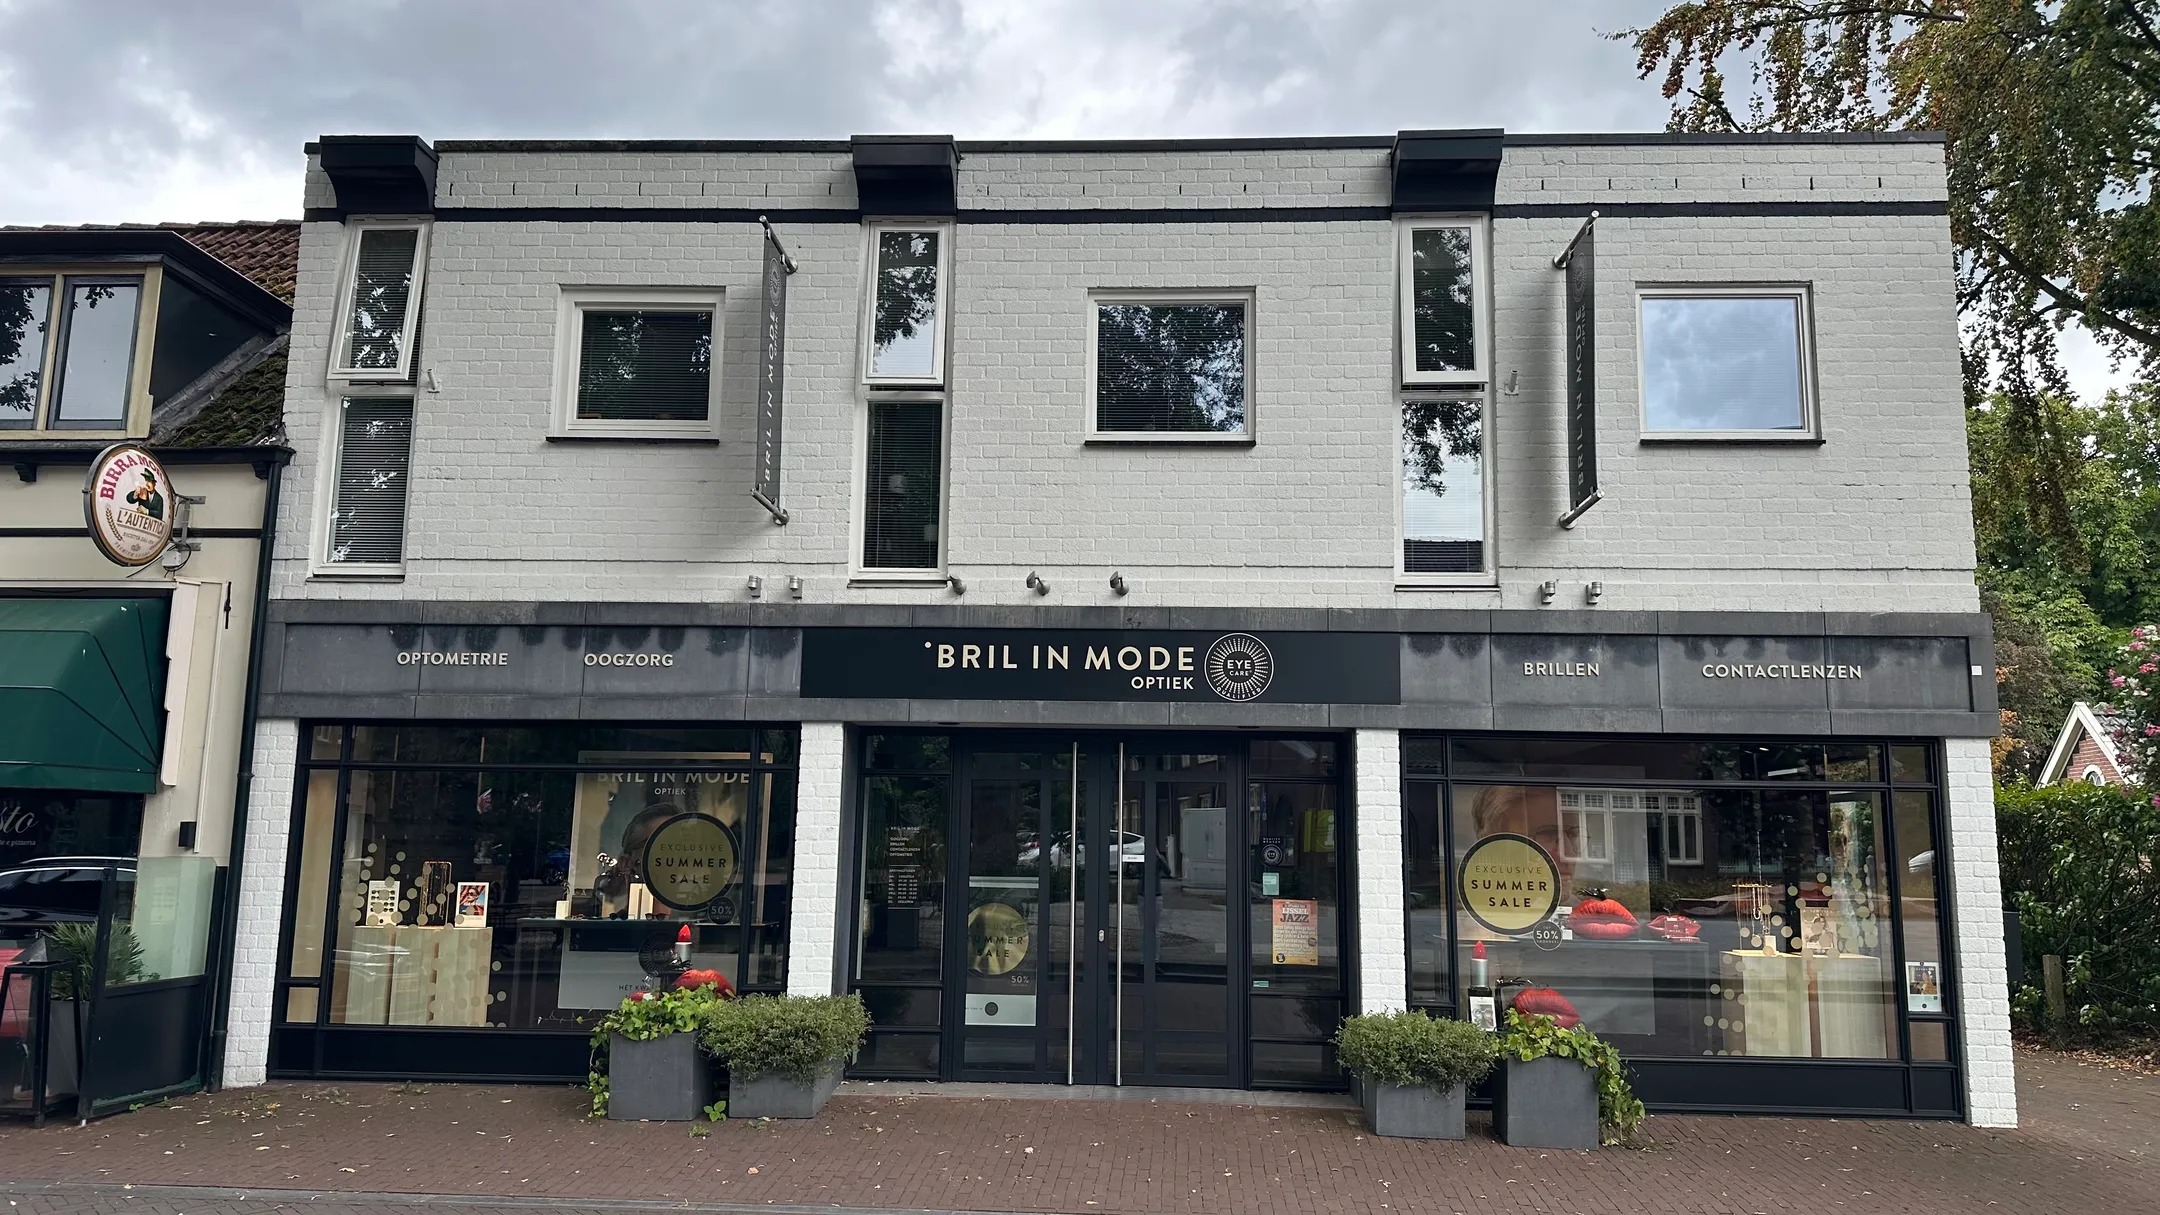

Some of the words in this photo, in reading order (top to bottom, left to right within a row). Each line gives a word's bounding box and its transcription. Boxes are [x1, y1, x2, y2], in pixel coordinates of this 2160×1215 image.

[767, 307, 776, 383] MODE
[1575, 306, 1583, 383] MODE
[766, 390, 773, 418] IN
[1576, 392, 1583, 420] IN
[764, 428, 772, 482] BRIL
[1576, 426, 1584, 486] BRIL
[100, 454, 138, 500] BIRRA
[396, 652, 509, 666] OPTOMETRIE
[584, 653, 674, 667] OOGZORG
[937, 644, 1018, 669] BRIL
[1032, 645, 1069, 670] IN
[1084, 645, 1195, 671] MODE
[1227, 660, 1252, 669] EYE
[1523, 662, 1600, 677] BRILLEN
[1702, 664, 1862, 679] CONTACTLENZEN
[1131, 676, 1194, 690] OPTIEK
[1216, 686, 1261, 699] QUALIFIED
[685, 773, 750, 784] MODE
[660, 843, 724, 852] EXCLUSIVE
[655, 857, 727, 868] SUMMER
[1475, 865, 1543, 875] EXCLUSIVE
[670, 874, 710, 884] SALE
[1471, 879, 1548, 891] SUMMER
[1489, 897, 1531, 908] SALE
[711, 905, 732, 915] 50%
[1280, 913, 1310, 923] JAZZ
[967, 935, 1024, 945] UMMER
[1536, 930, 1559, 940] 50%
[976, 949, 1010, 958] SALE
[1011, 975, 1029, 984] 50%
